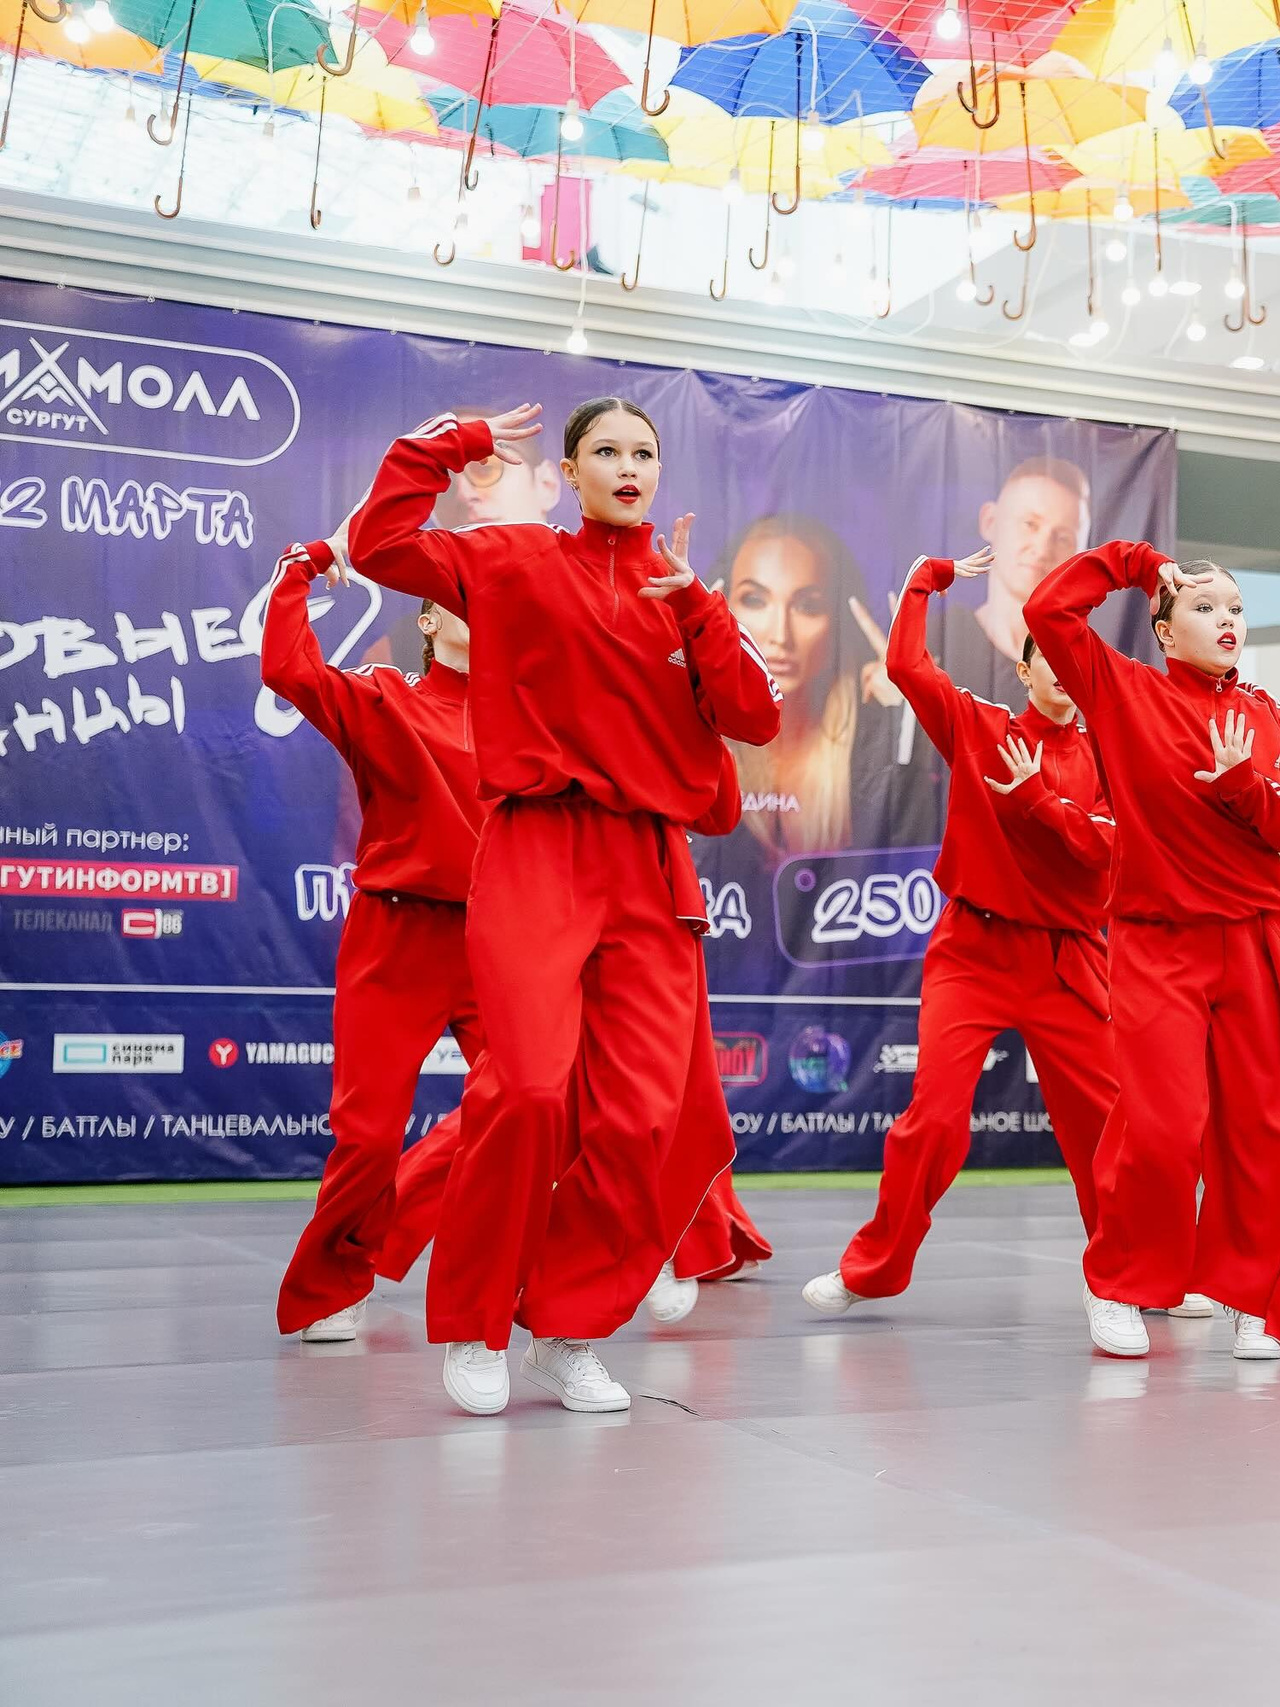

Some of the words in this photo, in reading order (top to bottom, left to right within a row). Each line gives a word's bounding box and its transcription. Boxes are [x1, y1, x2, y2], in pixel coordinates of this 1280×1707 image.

[6, 407, 89, 432] СУРГУТ
[61, 476, 254, 549] МАРТА
[0, 673, 186, 757] НЦЫ
[741, 791, 800, 813] ДИНА
[0, 823, 58, 847] ный
[66, 828, 190, 855] партнер:
[811, 868, 941, 943] 250
[13, 908, 112, 933] ТЕЛЕКАНАЛ
[42, 1115, 136, 1138] БАТТЛЫ
[729, 1112, 764, 1134] ОУ
[781, 1112, 855, 1134] БАТТЛЫ
